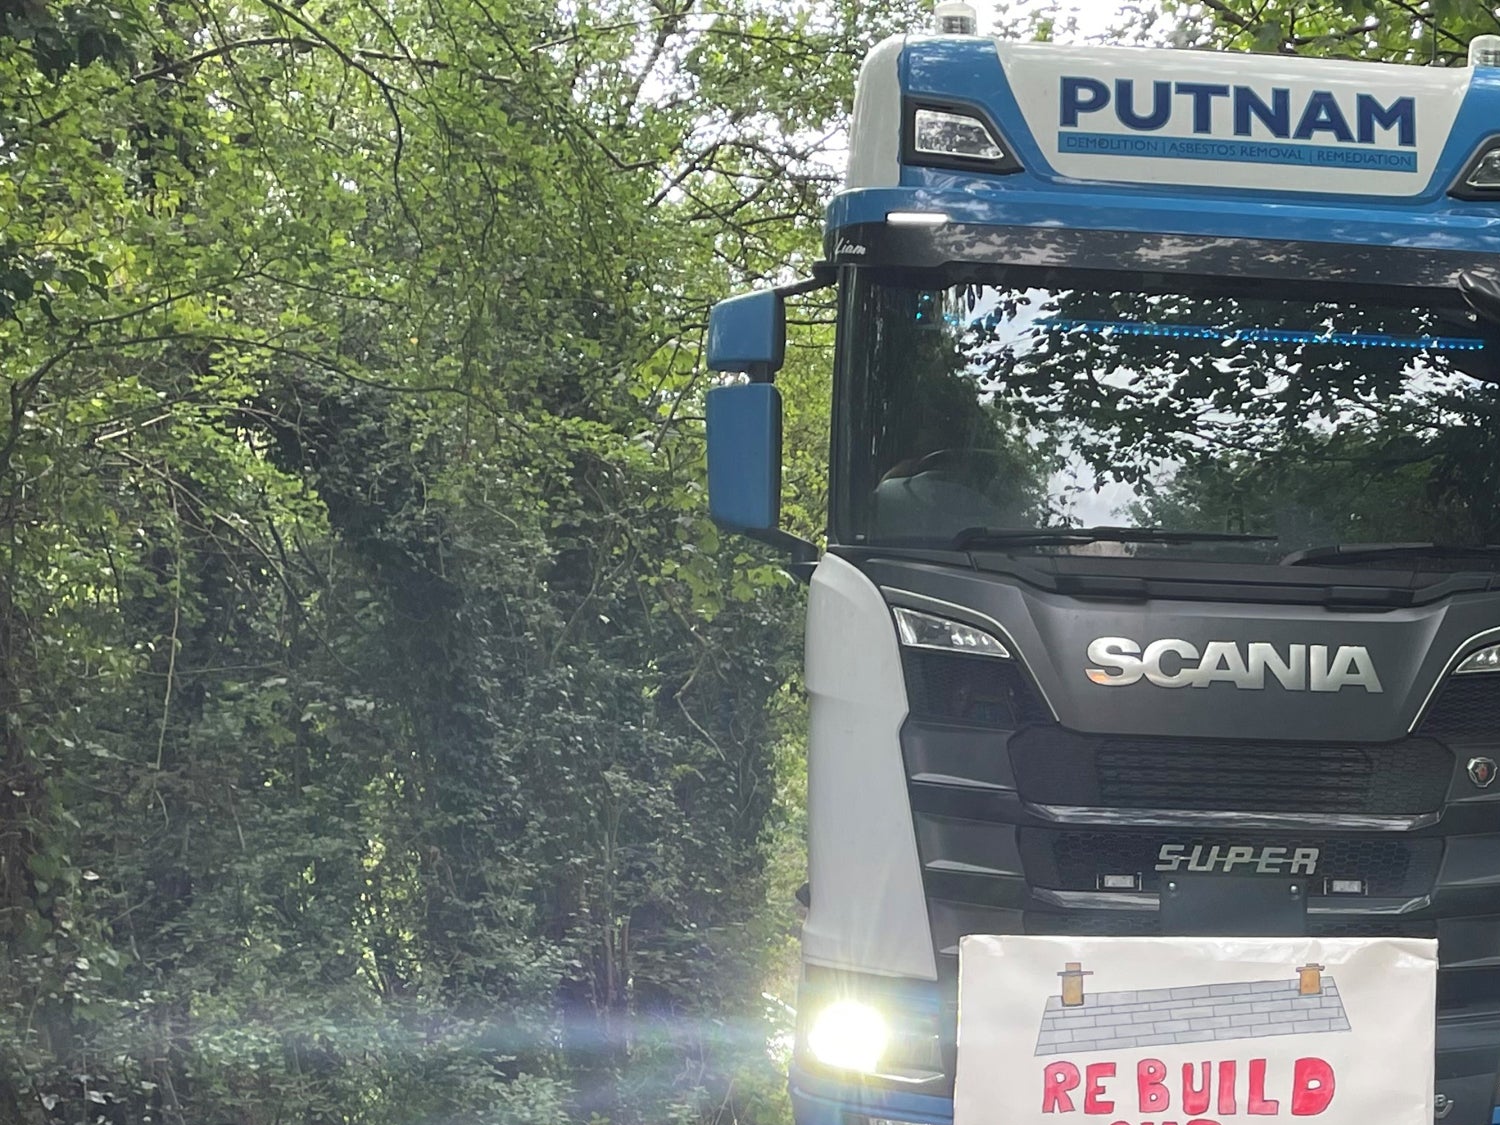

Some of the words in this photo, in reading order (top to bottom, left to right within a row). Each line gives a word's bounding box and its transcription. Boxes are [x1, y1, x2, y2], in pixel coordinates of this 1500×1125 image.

[1060, 76, 1416, 147] PUTNAM
[1066, 136, 1158, 152] DEMOLITION
[1169, 142, 1236, 156] ASBESTOS
[1240, 146, 1304, 161] REMOVAL
[1318, 151, 1412, 166] REMEDIATION
[834, 237, 866, 255] Liam
[1086, 636, 1383, 693] SCANIA
[1155, 844, 1319, 875] SUPER
